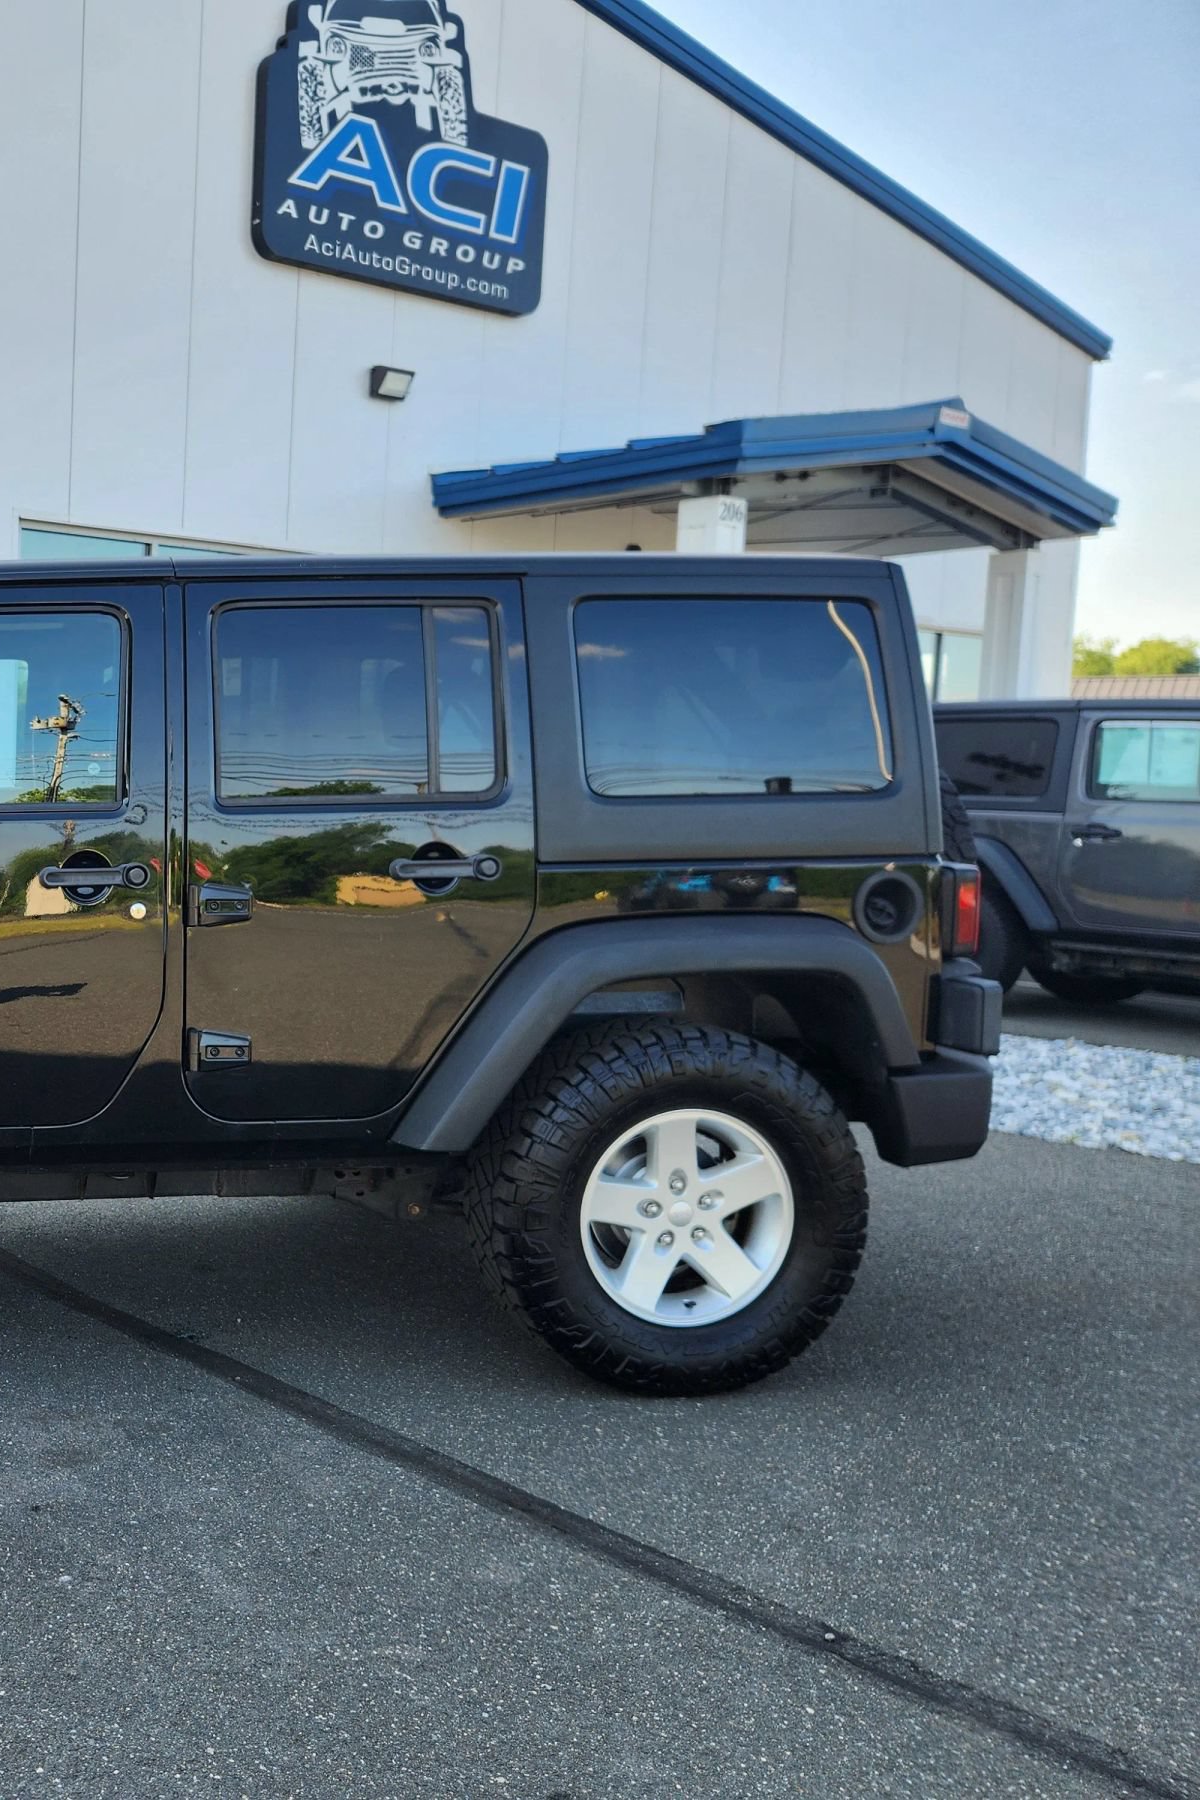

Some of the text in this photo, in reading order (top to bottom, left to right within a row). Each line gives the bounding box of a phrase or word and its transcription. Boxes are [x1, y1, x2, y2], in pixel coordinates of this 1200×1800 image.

[287, 111, 531, 244] ACI
[276, 198, 527, 275] AUTO GROUP
[303, 234, 510, 300] AciAutoGroup.com
